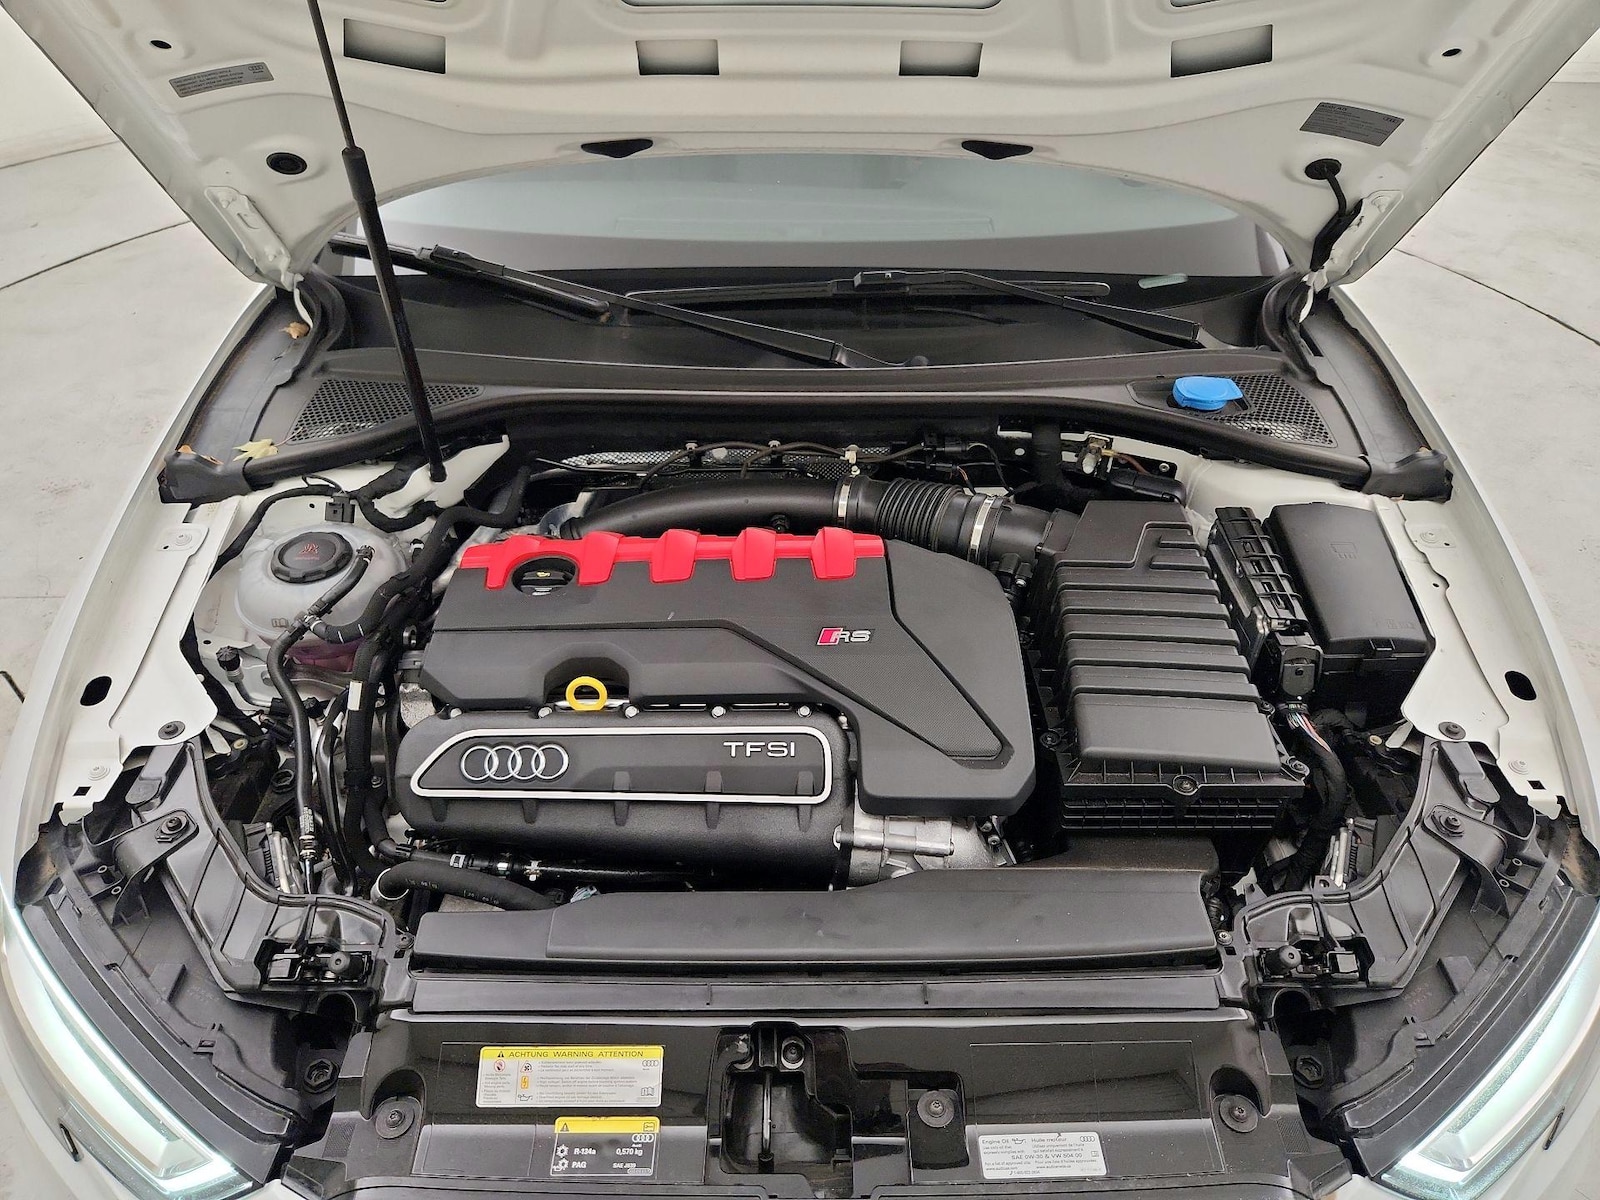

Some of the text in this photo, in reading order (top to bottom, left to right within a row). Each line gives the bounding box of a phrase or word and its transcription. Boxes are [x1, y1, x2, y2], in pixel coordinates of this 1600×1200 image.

[827, 629, 871, 643] RS
[723, 741, 796, 758] TFSI
[508, 1050, 644, 1058] ACHTUNG WARNING ATTENTION
[573, 1147, 597, 1155] R-134a
[634, 1148, 643, 1157] kg
[571, 1161, 587, 1169] PAG
